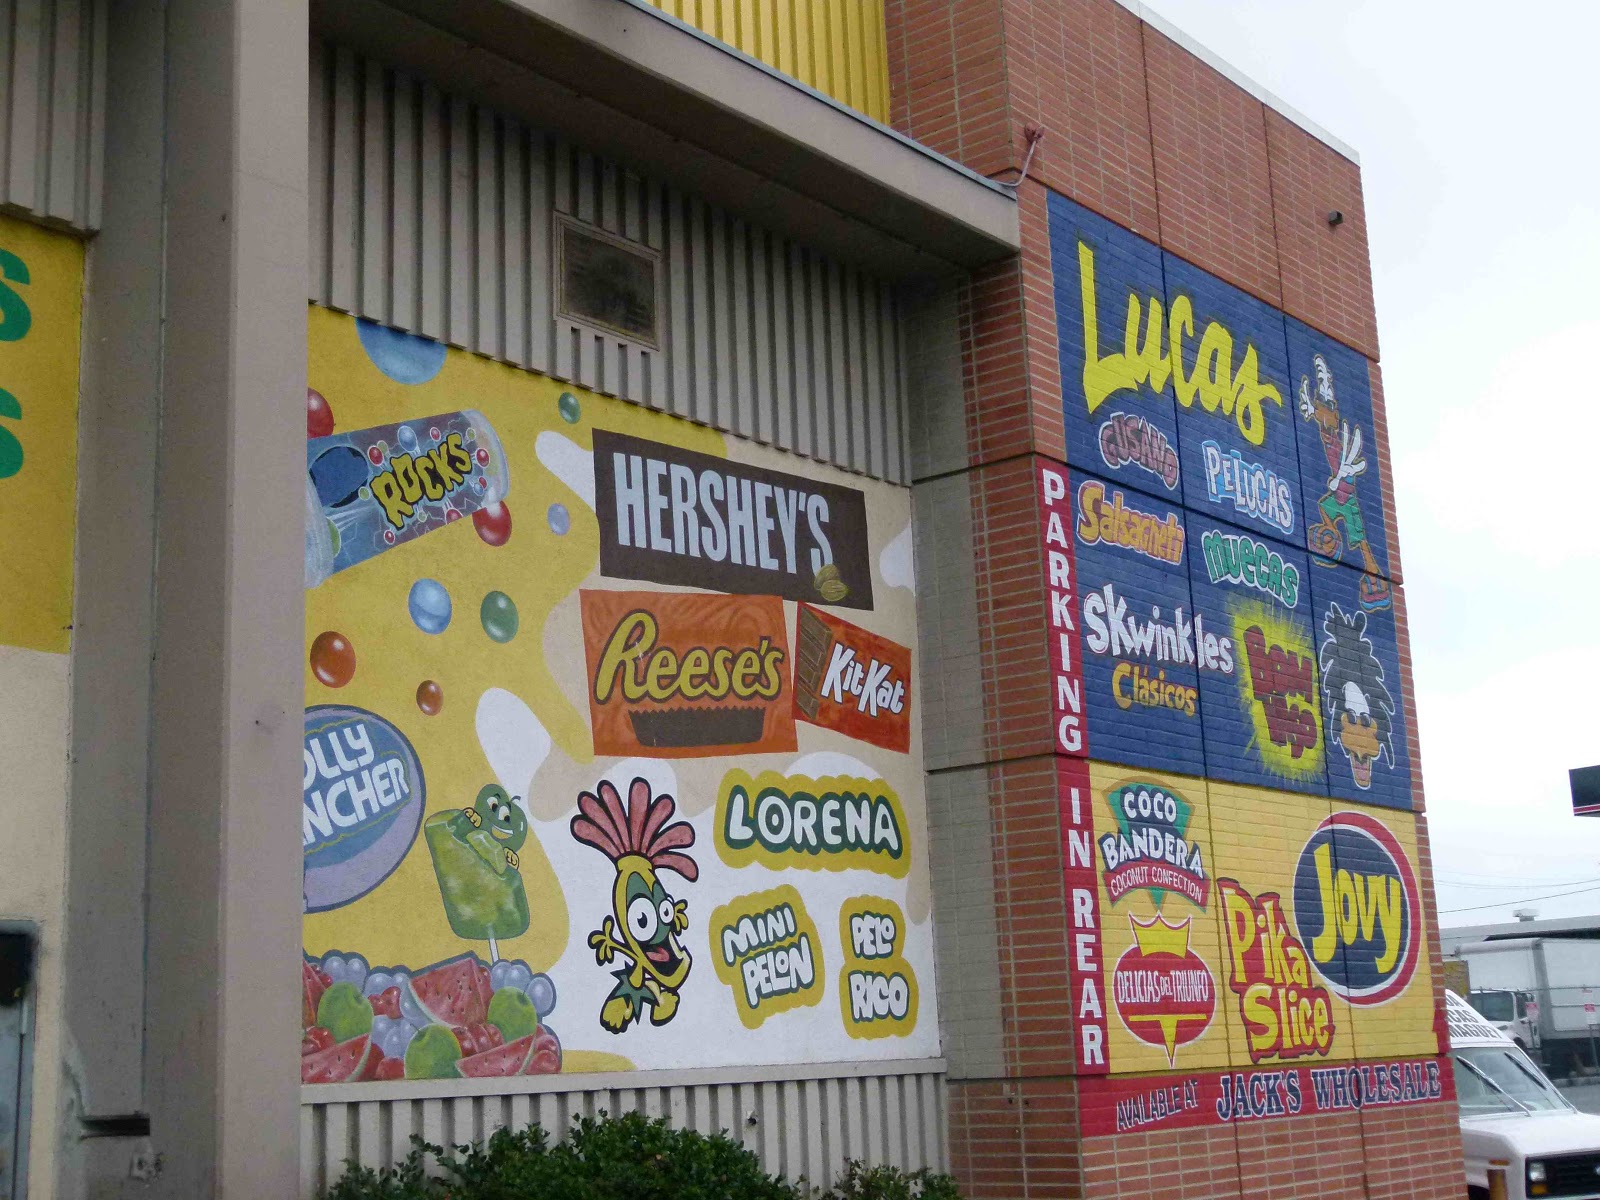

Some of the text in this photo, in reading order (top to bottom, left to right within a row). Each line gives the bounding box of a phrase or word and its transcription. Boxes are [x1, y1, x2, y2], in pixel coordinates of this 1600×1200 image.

[1078, 241, 1282, 446] Lucas
[370, 433, 474, 530] ROCKS
[613, 453, 834, 575] HERSHEY'S
[1202, 440, 1294, 534] PELUCAS
[1043, 469, 1083, 751] PARKING
[594, 609, 786, 706] Reese's
[304, 759, 409, 845] NCHER
[724, 785, 902, 859] LORENA
[1123, 790, 1177, 823] COCO
[1102, 828, 1204, 879] BANDERA
[1110, 866, 1203, 904] COCONUT CONFECTION
[722, 903, 797, 966] MINI
[850, 911, 895, 959] PELO
[1069, 788, 1104, 1065] IN REAR
[1222, 887, 1308, 989] Pika
[742, 932, 814, 1008] PELON
[849, 970, 909, 1022] RICO
[1117, 969, 1209, 1003] DELICIAS DEL TRIUNFO
[1243, 982, 1329, 1051] Slice
[1116, 1061, 1441, 1132] AVAILABLE AT JACK'S WHOLESALE
